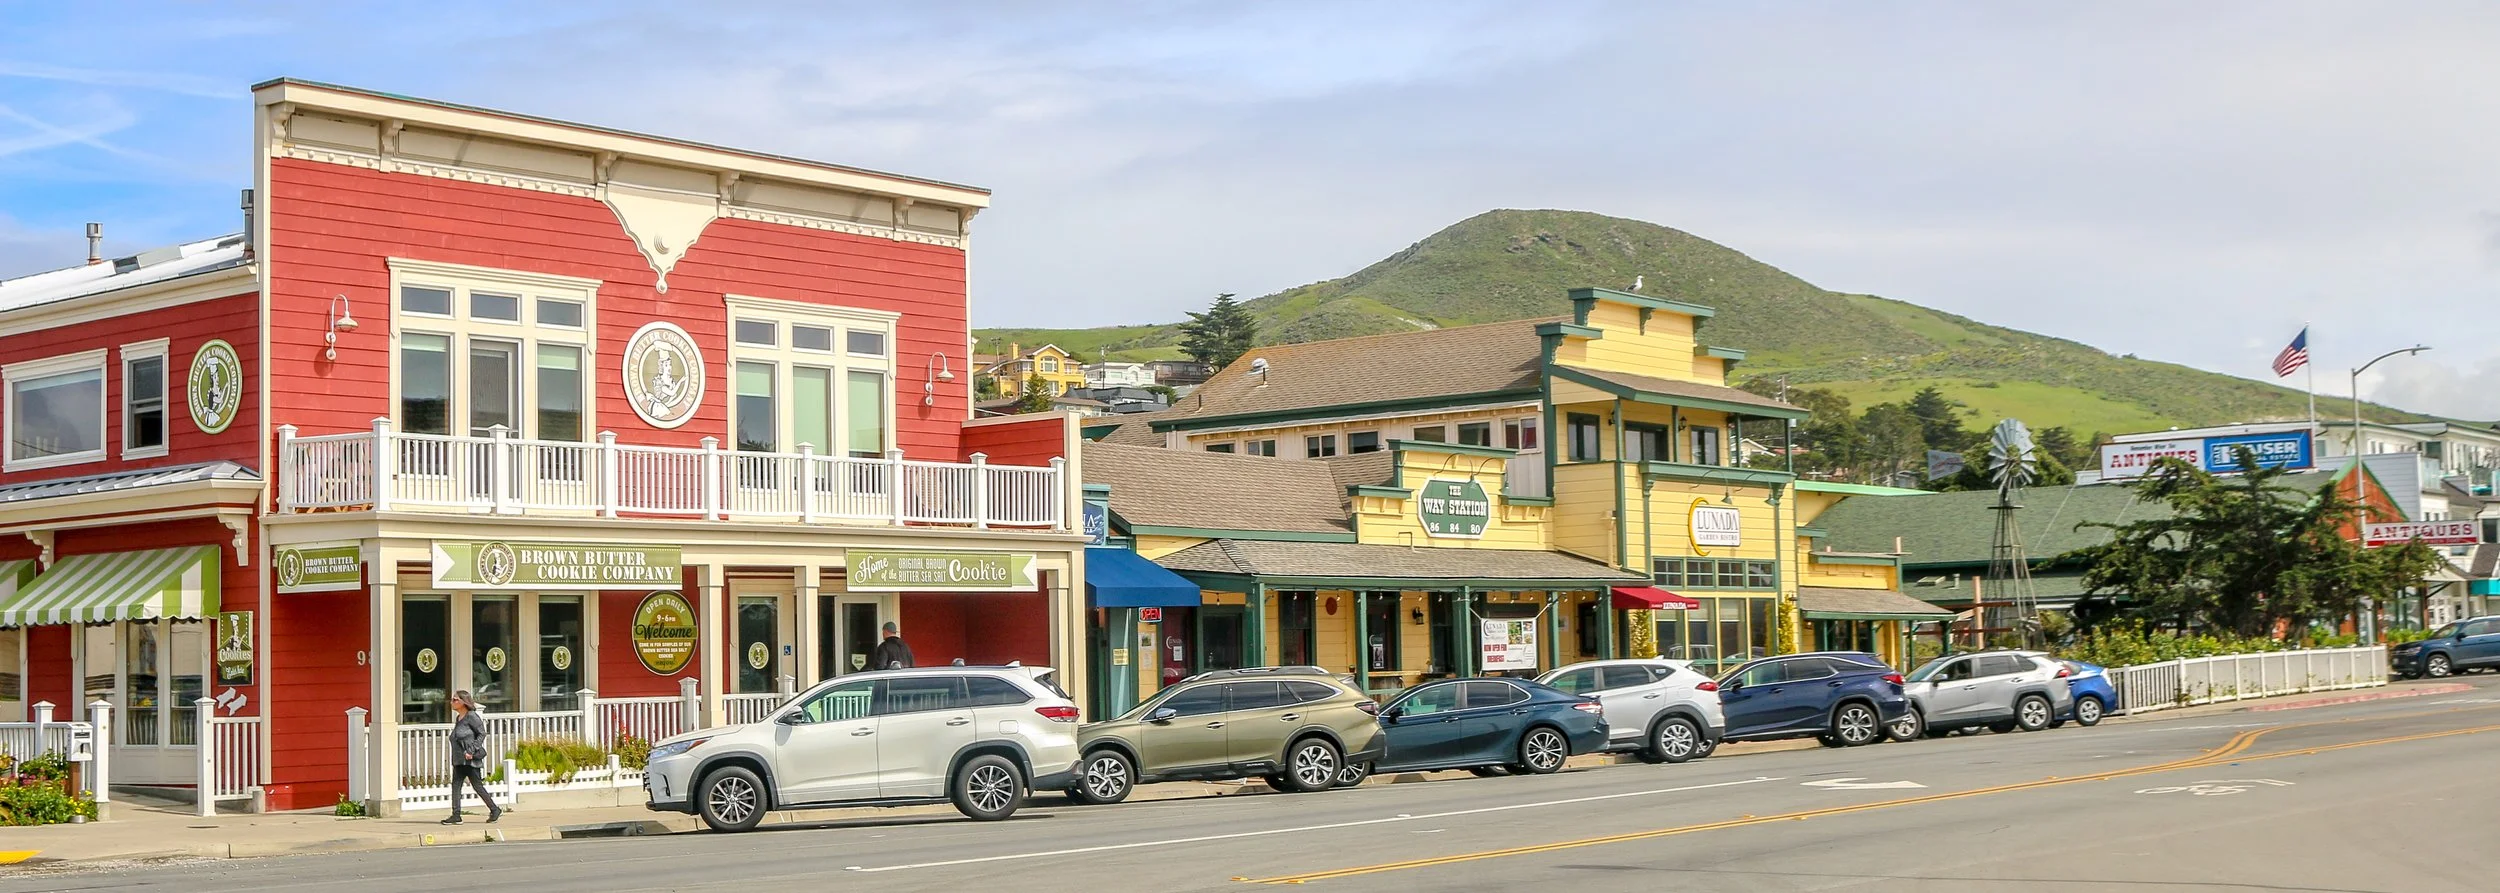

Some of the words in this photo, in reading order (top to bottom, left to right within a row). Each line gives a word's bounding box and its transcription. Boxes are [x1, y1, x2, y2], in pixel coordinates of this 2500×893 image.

[193, 350, 211, 383] BUTTER
[211, 347, 232, 364] COOKIE
[228, 365, 237, 411] COMPANY
[1448, 485, 1462, 496] THE
[1423, 498, 1445, 514] WAY
[1448, 500, 1487, 516] STATION
[1430, 522, 1440, 532] 86
[1449, 523, 1460, 533] 84
[1470, 524, 1481, 534] 80
[1697, 511, 1739, 530] LUNADA
[2373, 523, 2473, 538] ANTIQUES
[305, 557, 327, 567] BROWN
[329, 556, 354, 565] BUTTER
[520, 549, 579, 565] BROWN
[585, 551, 646, 566] BUTTER
[899, 557, 924, 570] ORIGINAL
[926, 558, 947, 570] BROWN
[305, 565, 329, 574] COOKIE
[330, 564, 359, 573] COMPANY
[537, 565, 597, 580] COOKIE
[603, 566, 675, 581] COMPANY
[854, 555, 889, 583] Home
[881, 571, 888, 582] of
[889, 569, 897, 580] the
[899, 570, 920, 582] BUTTER
[921, 571, 933, 583] SEA
[933, 571, 947, 583] SALT
[949, 558, 1007, 582] Cookie
[646, 598, 664, 614] OPEN
[666, 598, 686, 614] DAILY
[1140, 608, 1161, 620] OPEN
[635, 622, 693, 640] Welcome
[220, 647, 251, 662] Cookies
